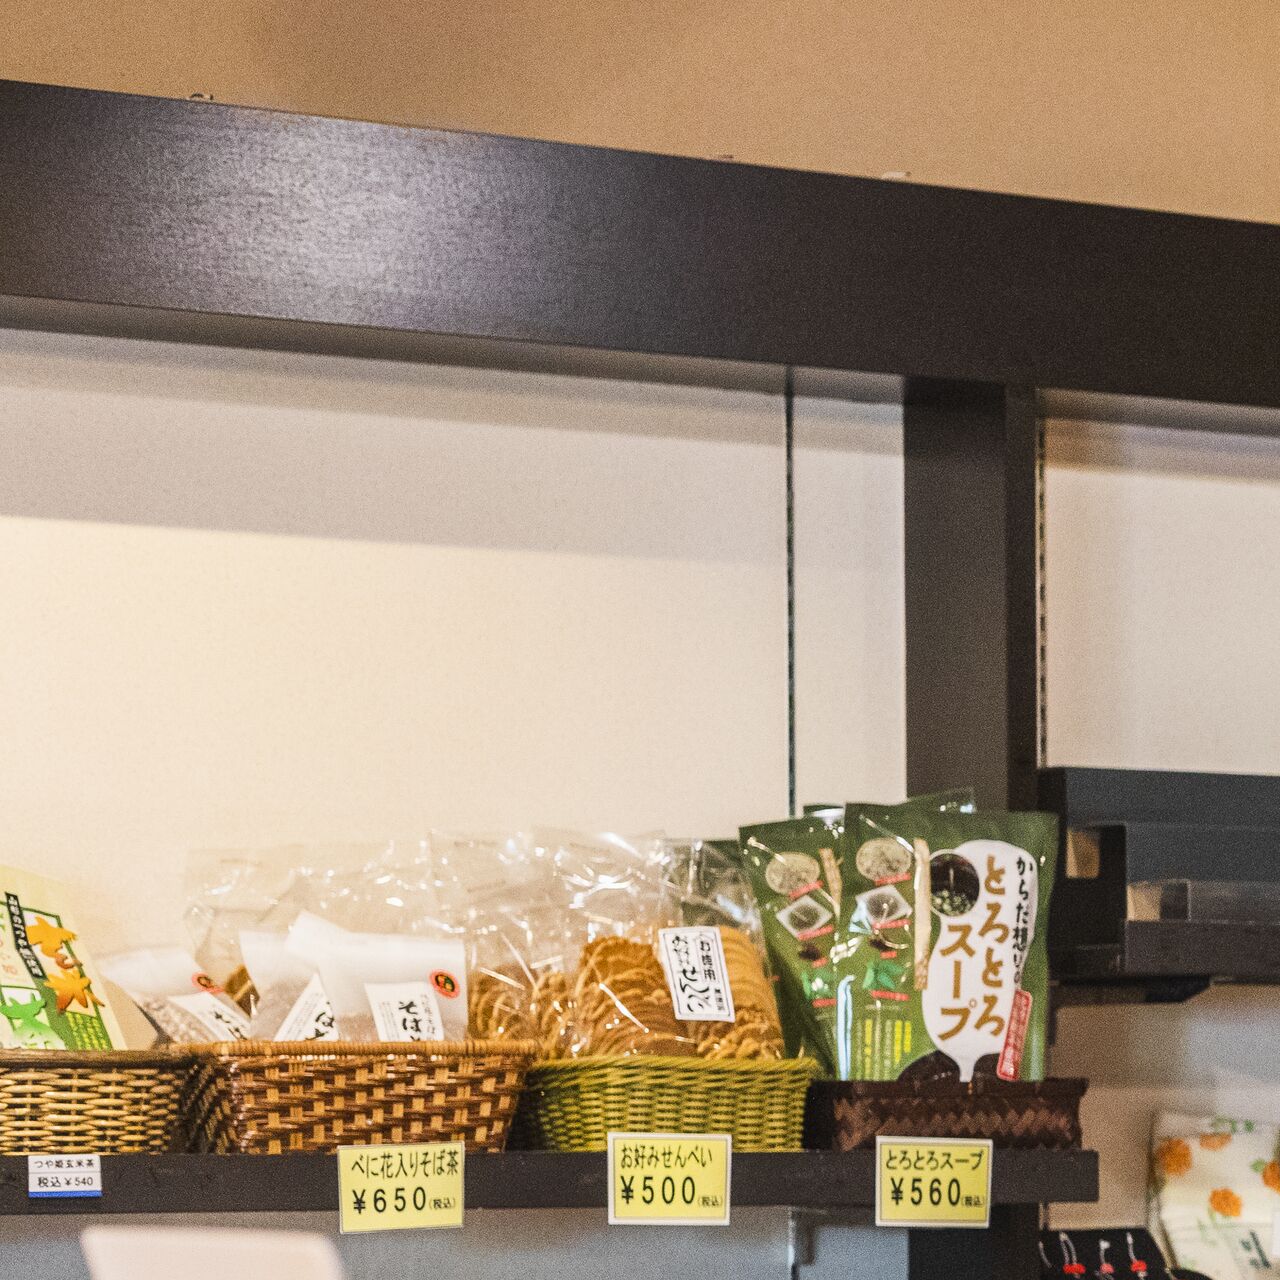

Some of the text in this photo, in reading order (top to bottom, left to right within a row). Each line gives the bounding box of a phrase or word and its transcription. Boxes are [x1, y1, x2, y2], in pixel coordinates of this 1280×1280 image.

[974, 855, 1009, 1036] とろとろ
[938, 924, 977, 1041] スープ
[34, 1159, 95, 1170] つや姫玄米茶
[351, 1149, 459, 1180] べに花入りそば茶
[620, 1143, 713, 1170] お好みせんべい
[885, 1149, 984, 1172] とろとろスープ
[352, 1188, 426, 1215] ¥650
[620, 1175, 696, 1205] ¥500
[891, 1177, 961, 1207] ¥560
